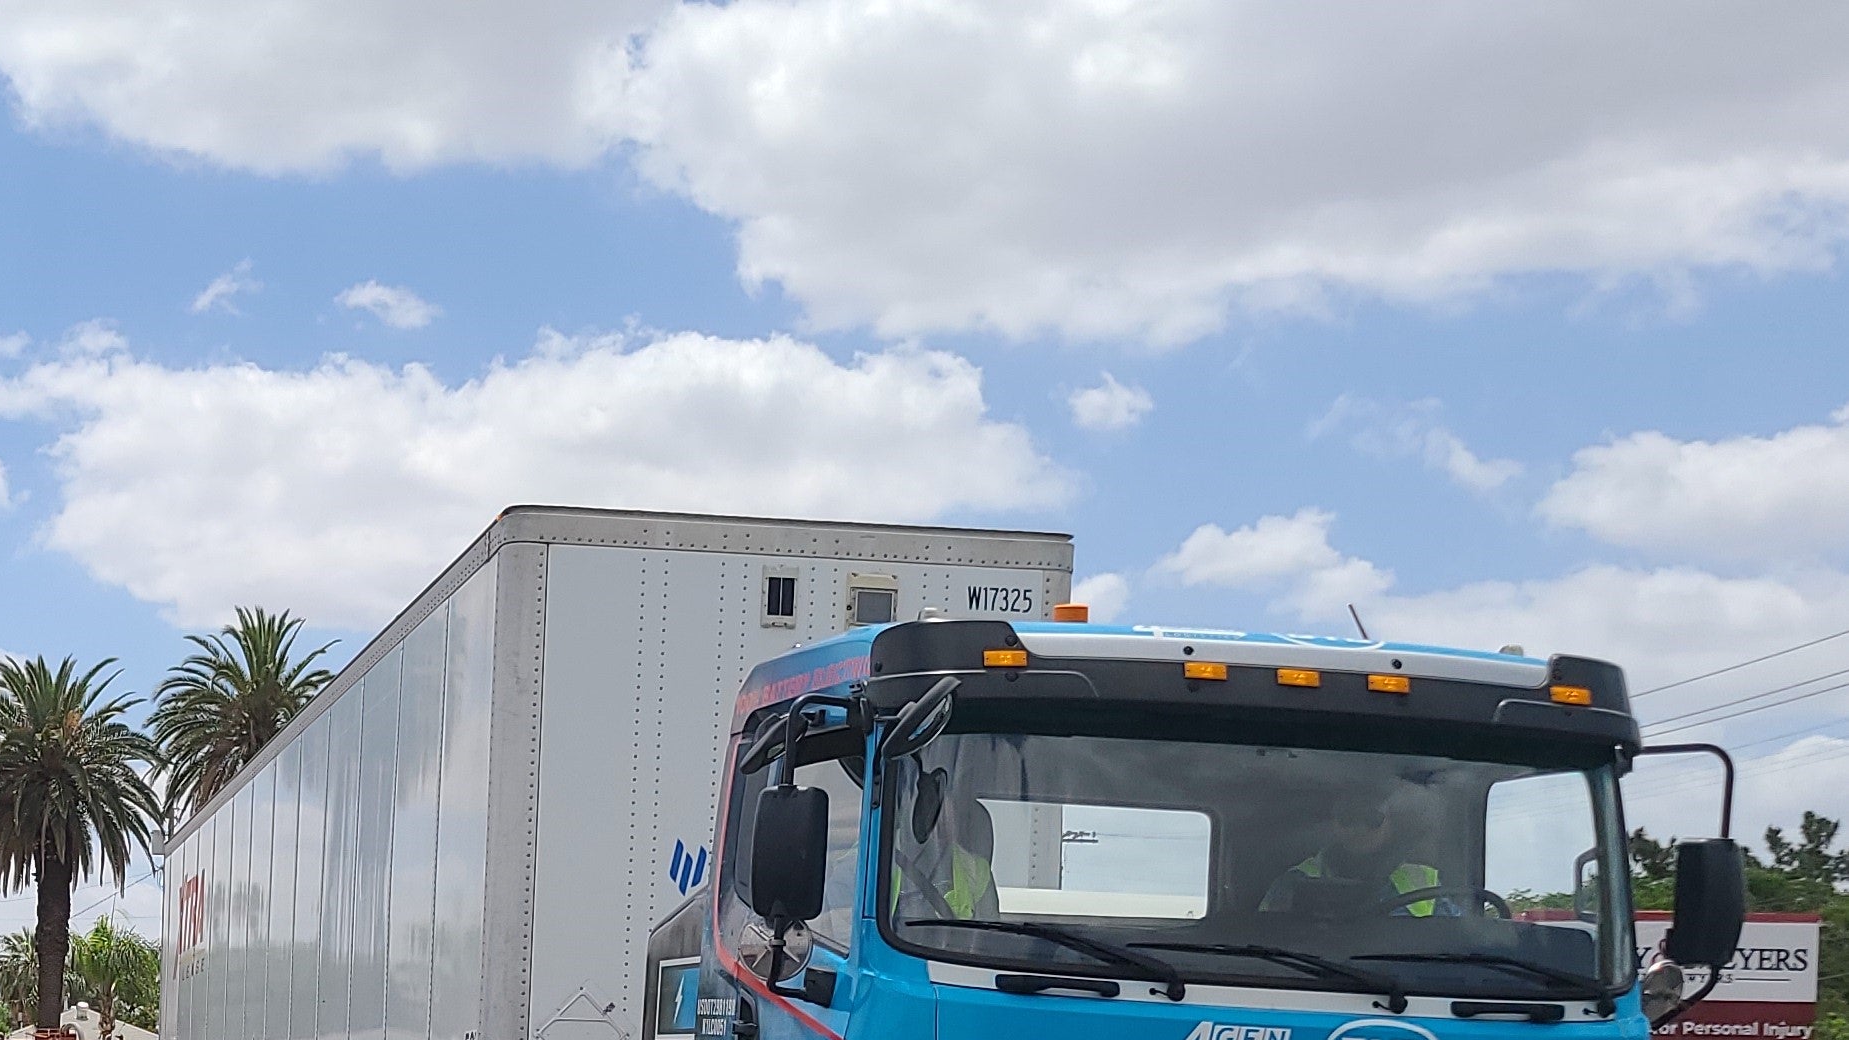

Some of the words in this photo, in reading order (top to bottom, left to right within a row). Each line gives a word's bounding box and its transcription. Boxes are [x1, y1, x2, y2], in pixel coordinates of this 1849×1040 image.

[968, 586, 1033, 613] W17325
[1682, 1021, 1759, 1036] Personal
[1763, 1021, 1813, 1039] Injury
